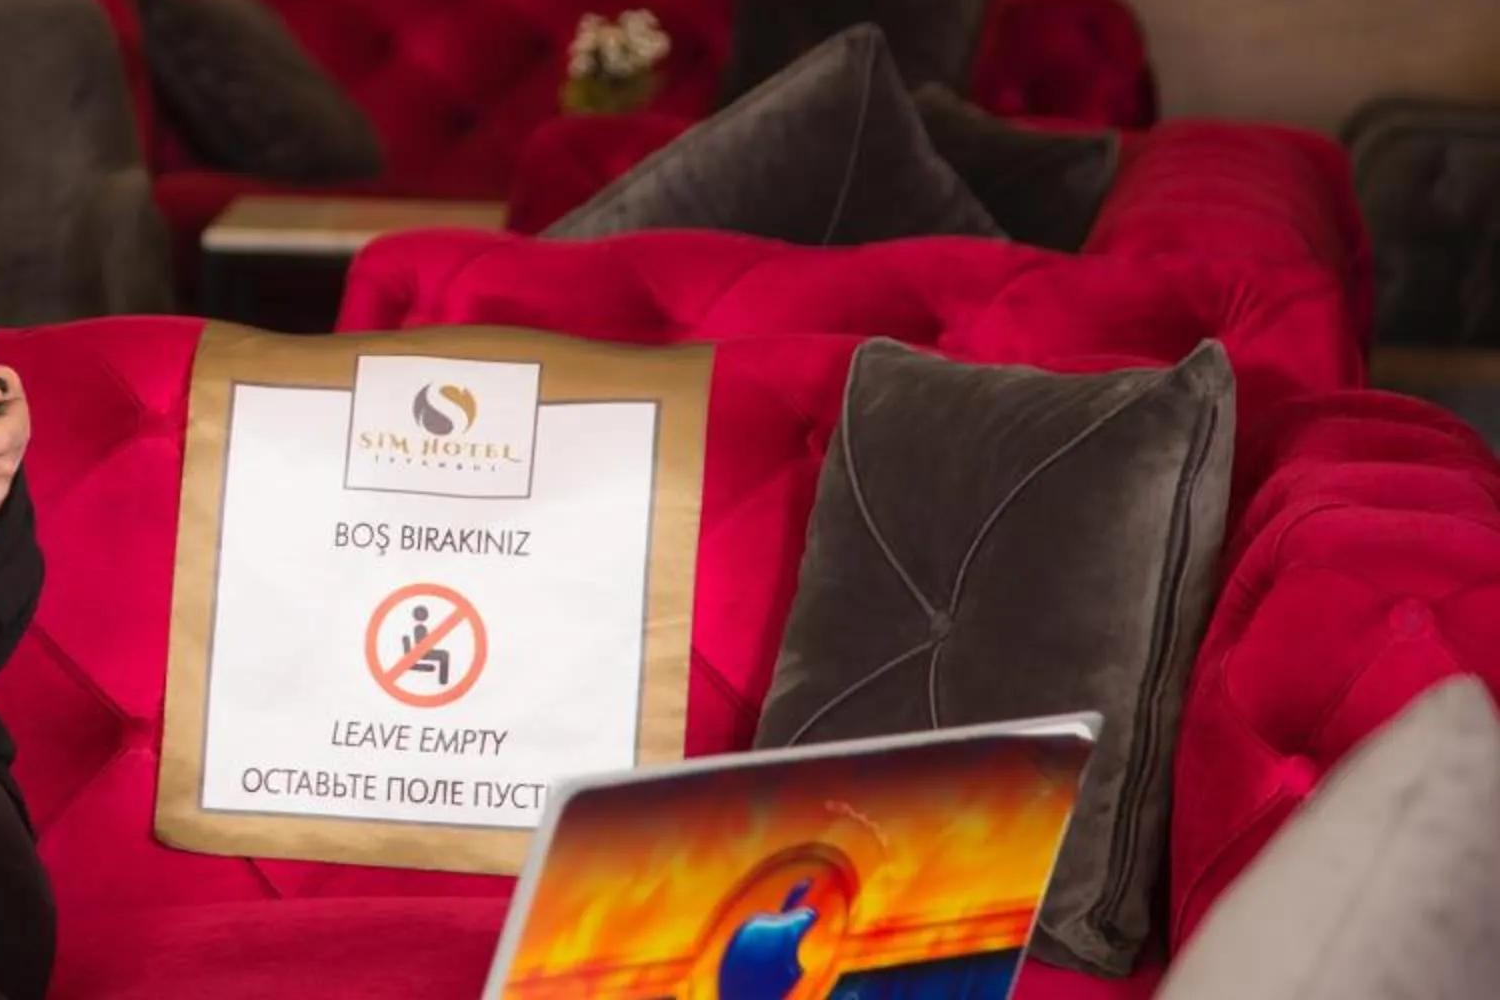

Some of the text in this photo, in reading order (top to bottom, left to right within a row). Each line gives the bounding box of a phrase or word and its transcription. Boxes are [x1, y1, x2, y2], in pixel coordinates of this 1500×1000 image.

[360, 430, 524, 463] SIM HOTEL
[334, 522, 531, 556] BOŞ BIRAKINIZ
[331, 720, 508, 756] LEAVE EMPTY
[242, 767, 546, 810] ОСТАВЬТЕ ПОЛЕ ПУСТ
